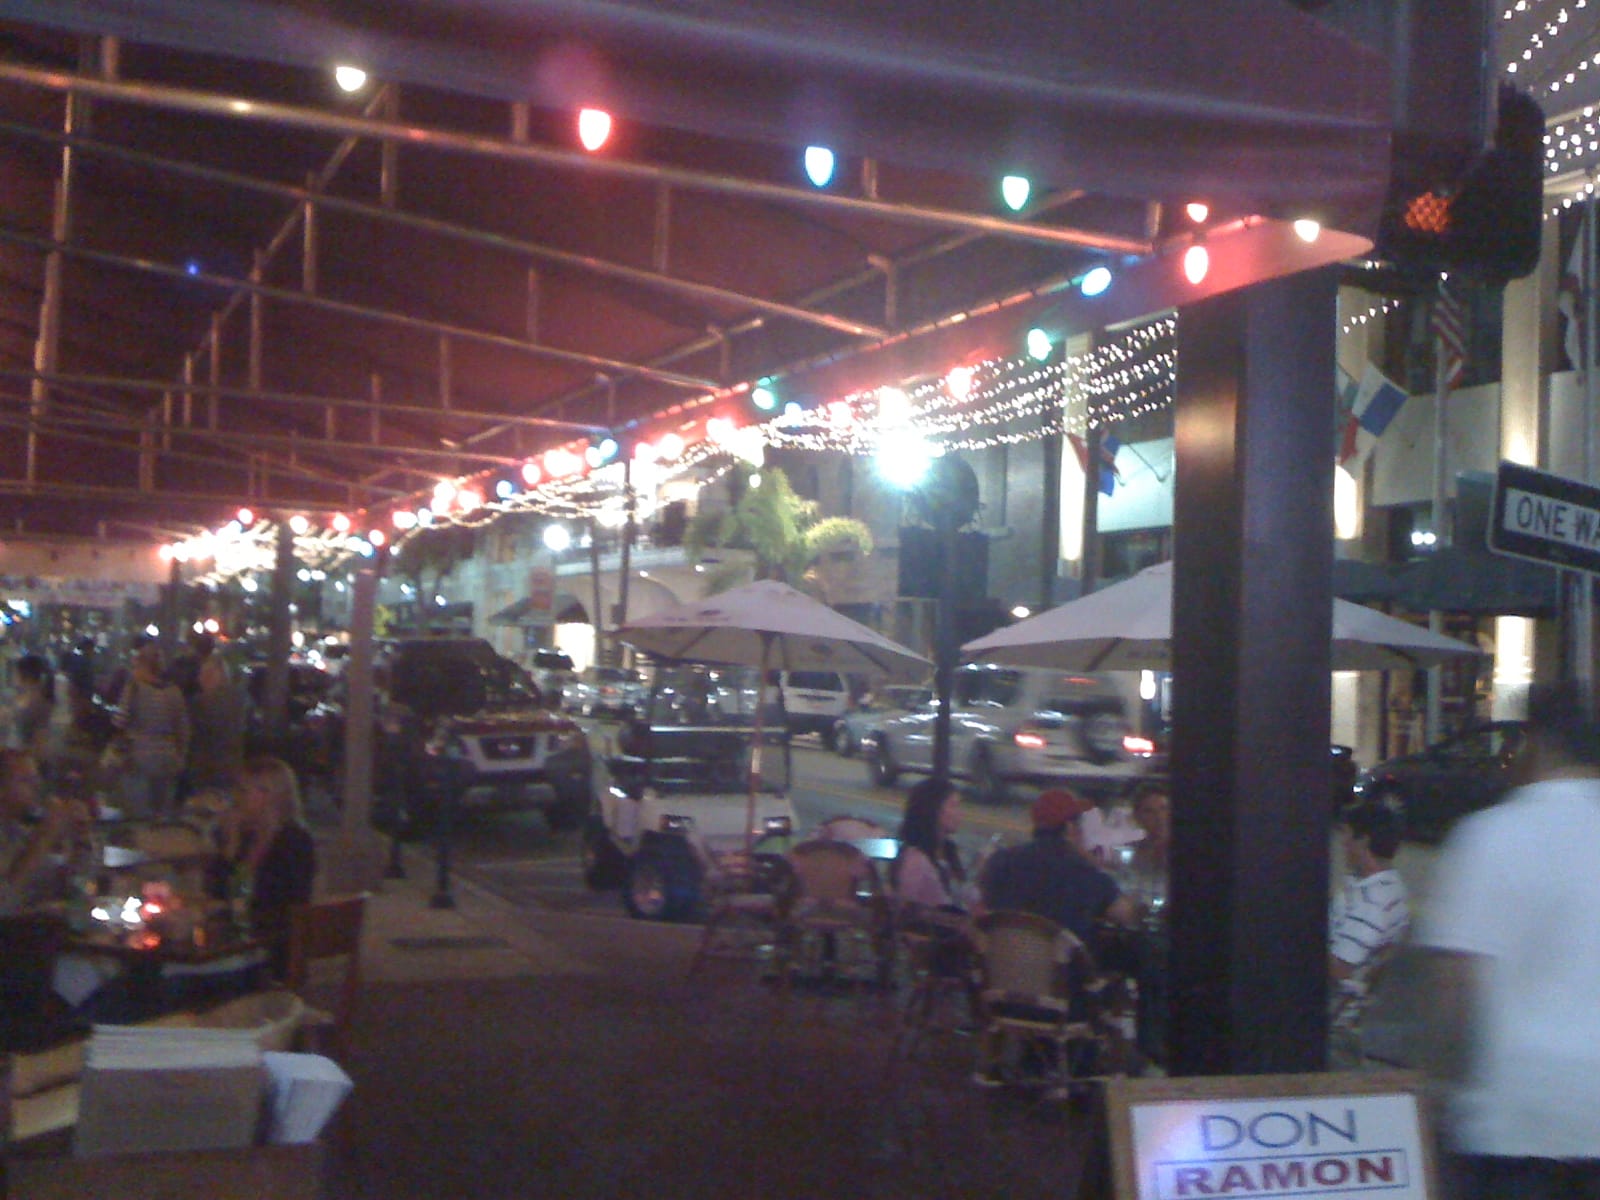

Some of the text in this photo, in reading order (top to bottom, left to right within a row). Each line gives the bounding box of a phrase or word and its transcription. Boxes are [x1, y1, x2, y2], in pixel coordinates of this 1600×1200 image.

[1516, 496, 1567, 537] ONE
[1201, 1109, 1358, 1152] DON
[1174, 1156, 1394, 1196] RAMON
